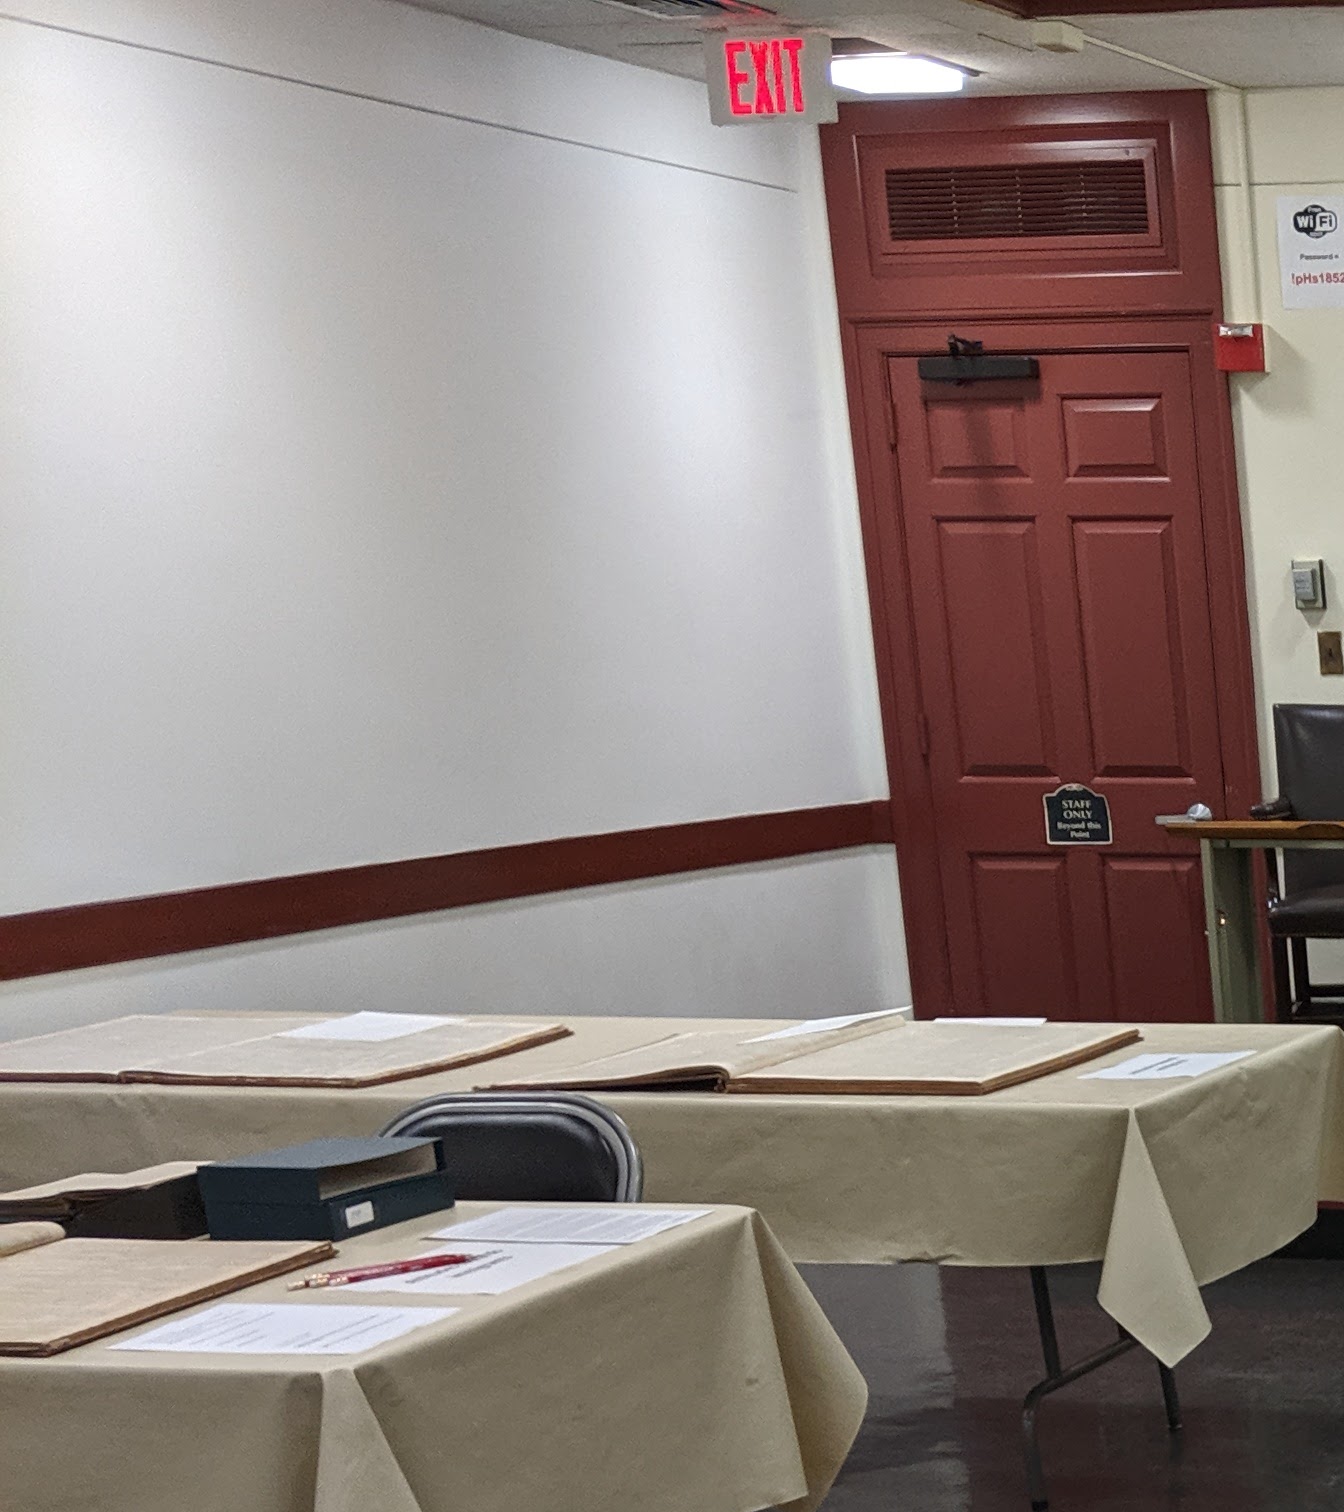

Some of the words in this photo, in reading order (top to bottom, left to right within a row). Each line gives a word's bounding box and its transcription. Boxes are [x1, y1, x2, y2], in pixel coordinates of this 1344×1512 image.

[725, 40, 804, 114] EXIT
[1062, 800, 1091, 809] STAFF
[1063, 810, 1093, 819] ONLY
[1057, 821, 1085, 831] Beyond
